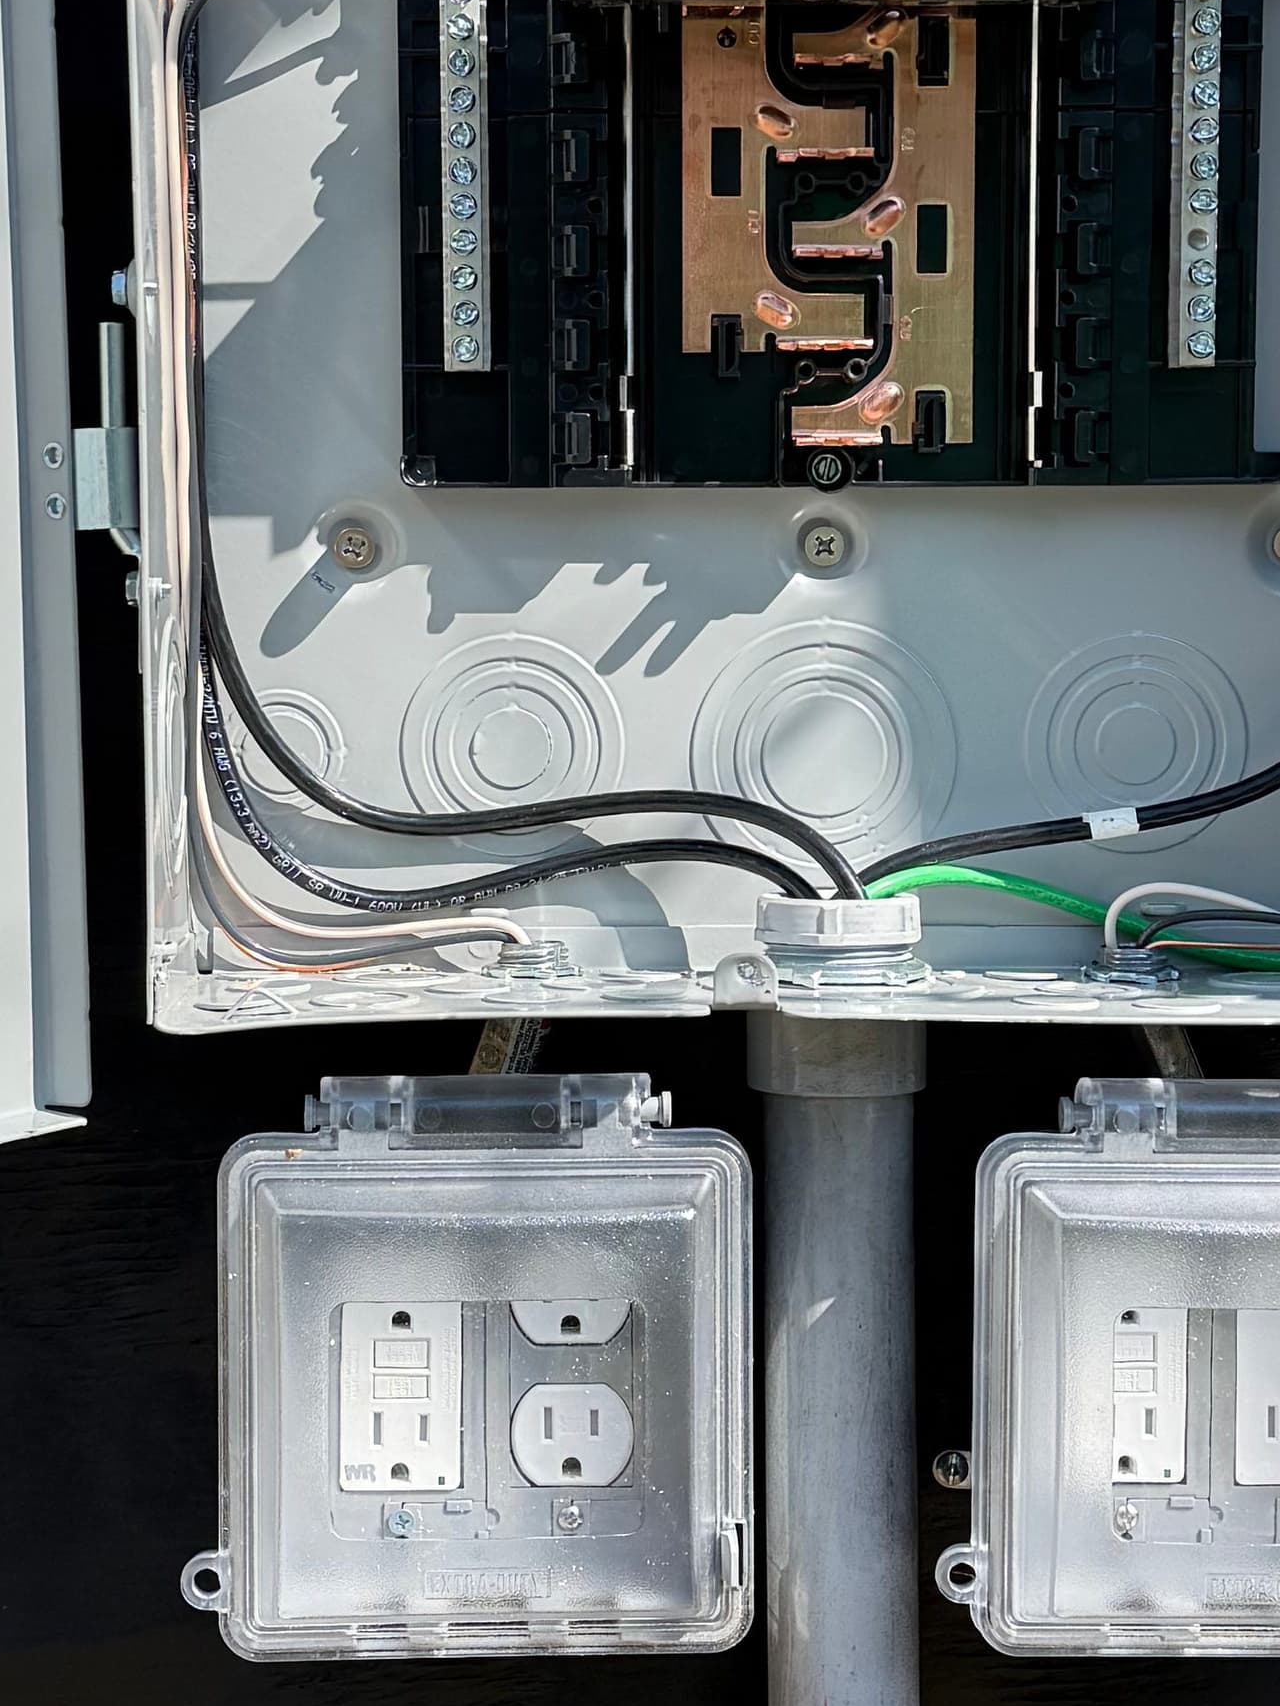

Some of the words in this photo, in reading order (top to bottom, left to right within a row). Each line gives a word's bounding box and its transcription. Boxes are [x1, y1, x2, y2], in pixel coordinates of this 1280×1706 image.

[208, 731, 216, 741] 6
[212, 746, 232, 773] AWG
[368, 901, 403, 914] 600V
[344, 1463, 377, 1483] WR
